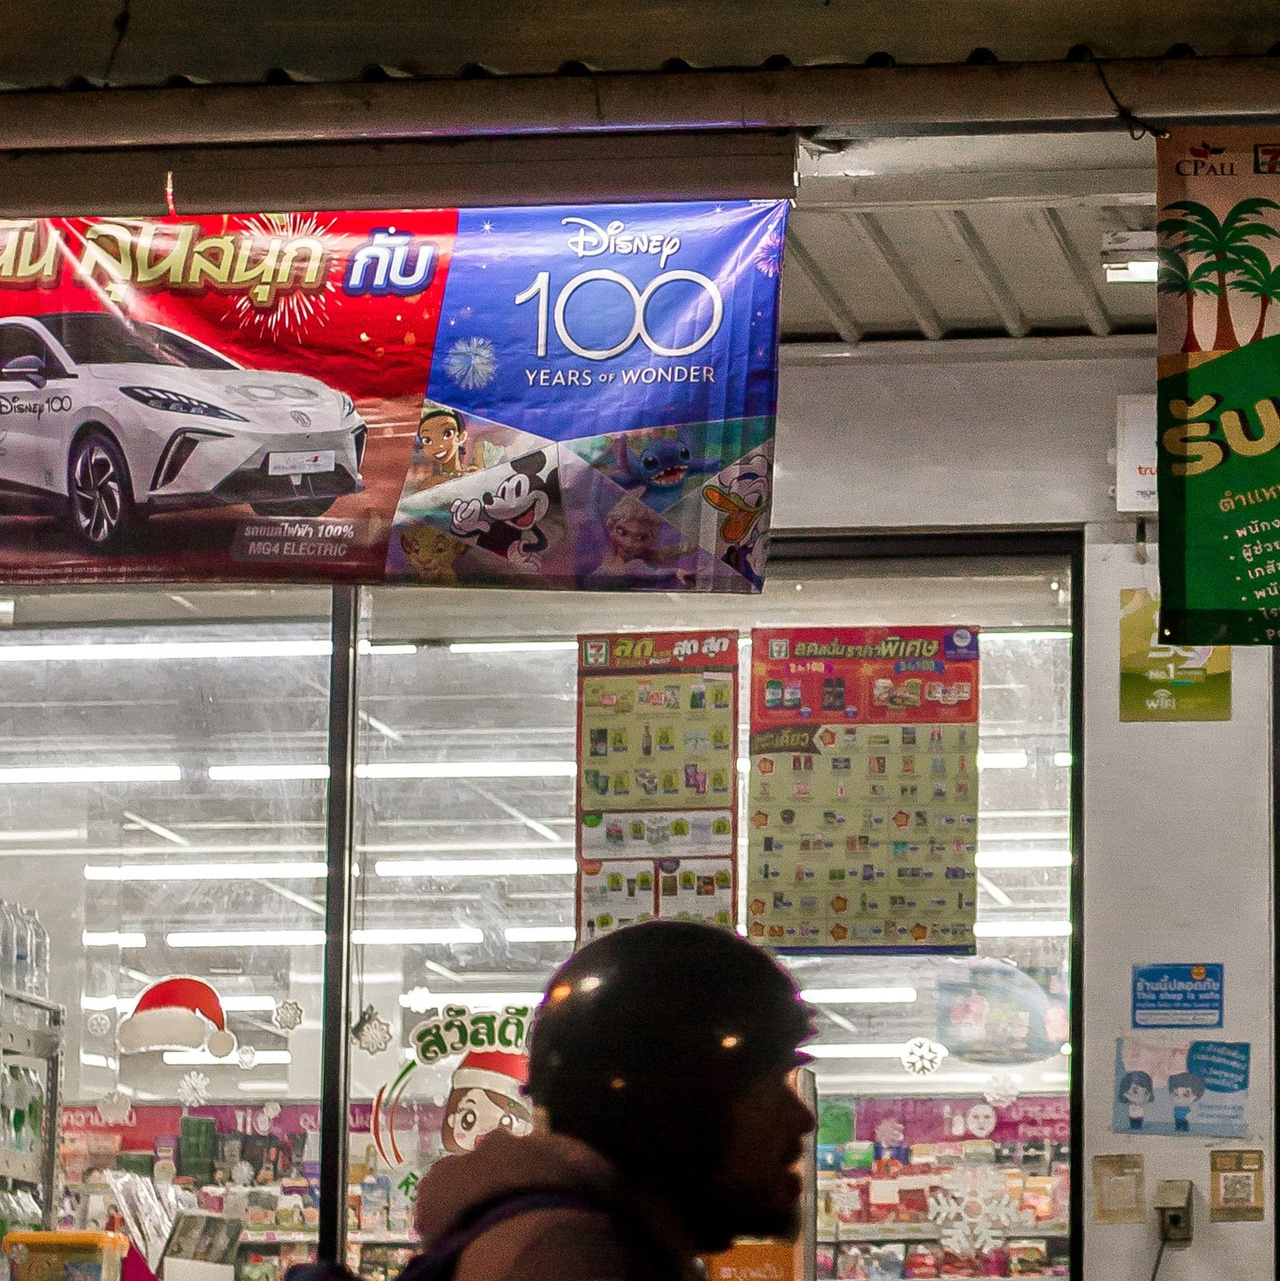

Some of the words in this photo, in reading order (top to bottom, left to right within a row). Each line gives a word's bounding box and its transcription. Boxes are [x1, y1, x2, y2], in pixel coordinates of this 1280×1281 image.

[350, 228, 434, 287] กับ
[515, 269, 725, 361] 100
[525, 368, 592, 387] YEARS
[620, 365, 716, 386] WONDER
[45, 395, 73, 413] 100
[1137, 464, 1158, 476] tru
[317, 524, 355, 539] 100%
[248, 541, 281, 556] MG4
[283, 541, 348, 557] ELECTRIC
[415, 1006, 530, 1061] สวัสดี
